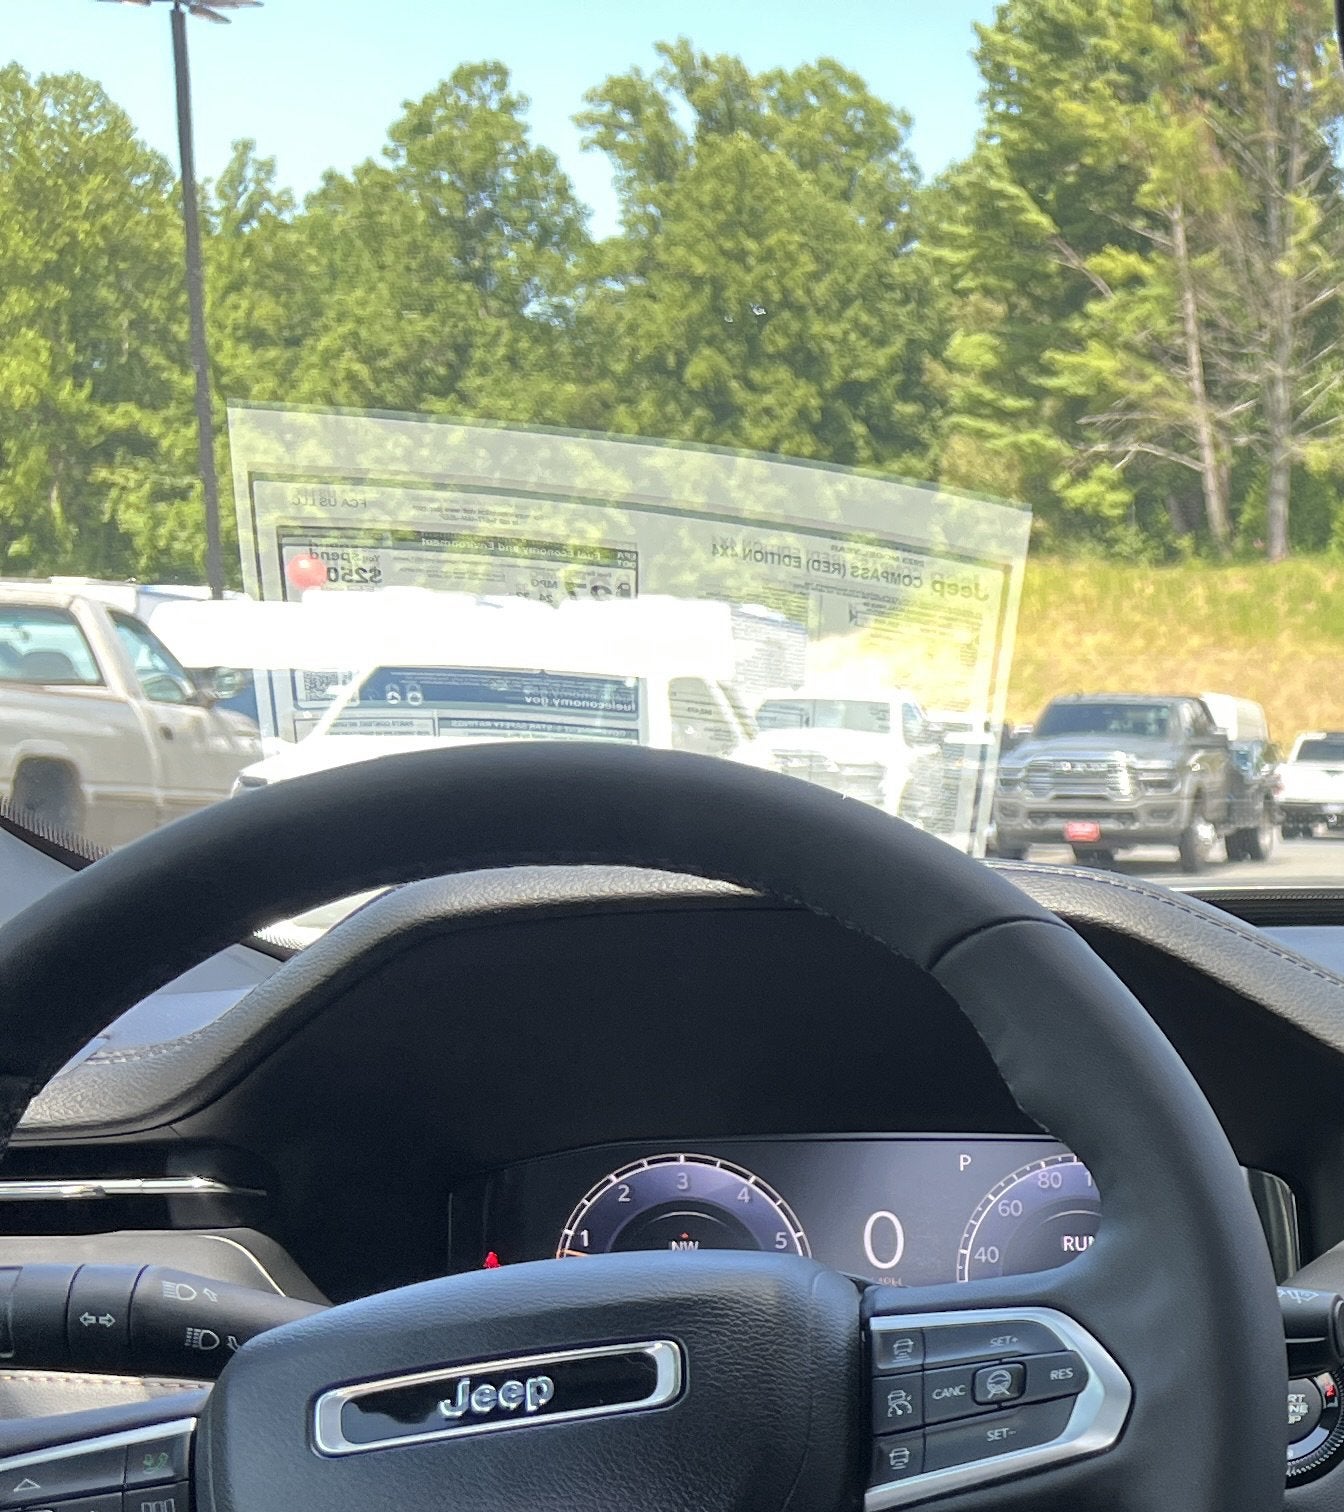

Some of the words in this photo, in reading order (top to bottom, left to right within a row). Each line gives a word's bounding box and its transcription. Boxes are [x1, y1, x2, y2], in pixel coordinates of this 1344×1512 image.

[959, 1154, 972, 1171] P
[677, 1172, 689, 1190] 3
[1037, 1171, 1062, 1189] 80
[617, 1184, 631, 1202] 2
[737, 1187, 750, 1203] 4
[998, 1200, 1023, 1217] 60
[580, 1229, 589, 1247] 1
[774, 1231, 788, 1249] 5
[863, 1209, 905, 1270] 0
[974, 1246, 1000, 1263] 40
[1049, 1367, 1074, 1381] RES
[438, 1375, 556, 1418] Jeep
[931, 1384, 967, 1399] CANC
